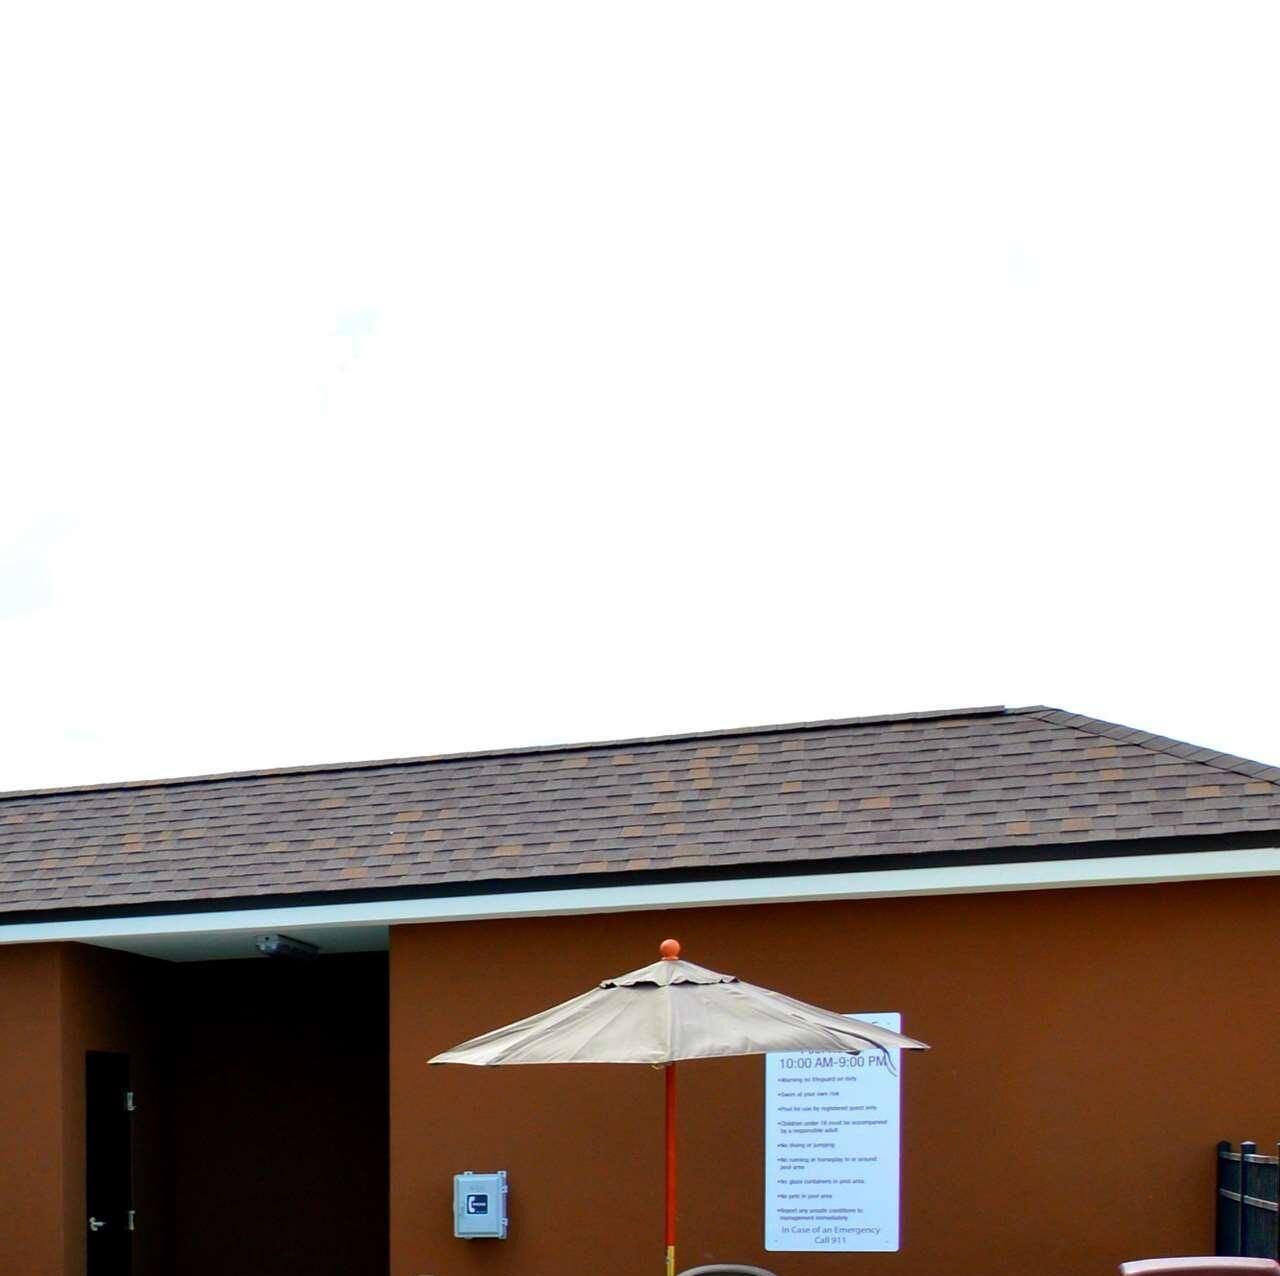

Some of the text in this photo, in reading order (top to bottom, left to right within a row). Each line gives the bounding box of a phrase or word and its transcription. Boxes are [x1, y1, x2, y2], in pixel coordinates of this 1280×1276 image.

[780, 1055, 887, 1069] 10:00 AM-9:00 PM
[782, 1226, 790, 1234] In
[791, 1226, 810, 1234] Case
[812, 1225, 821, 1234] of
[834, 1226, 880, 1235] Emergency
[814, 1236, 830, 1244] Call
